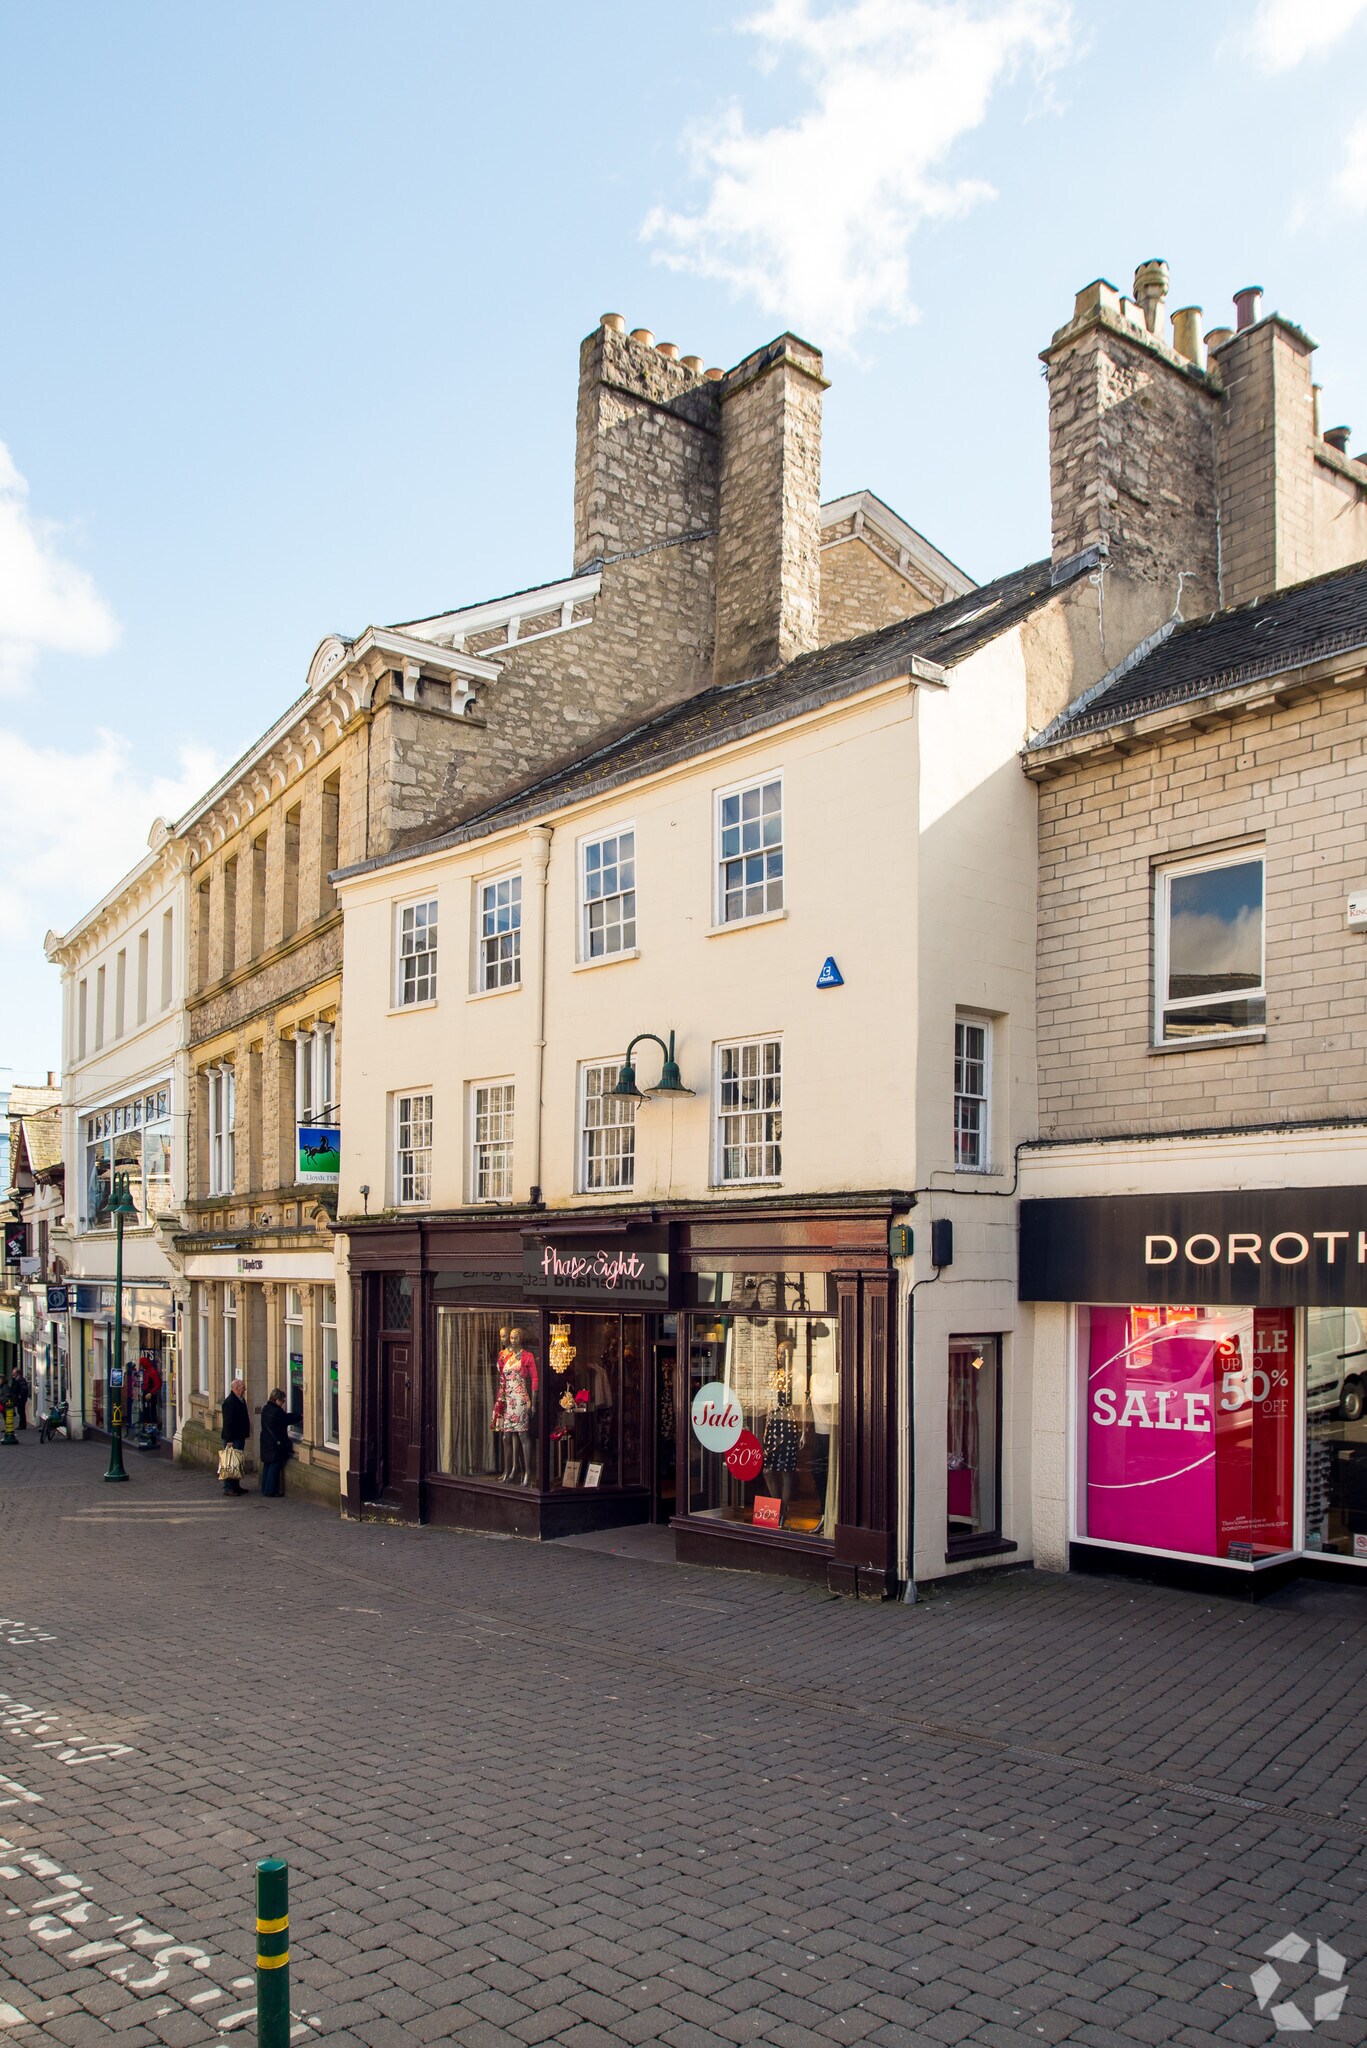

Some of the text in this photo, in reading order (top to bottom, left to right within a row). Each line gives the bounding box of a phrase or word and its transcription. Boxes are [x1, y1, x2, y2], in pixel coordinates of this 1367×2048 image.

[306, 1174, 325, 1182] Lloyds
[1145, 1231, 1367, 1265] DOROT
[541, 1246, 645, 1289] Phase Eight
[1220, 1330, 1288, 1355] SALE
[1221, 1358, 1240, 1371] UP
[1220, 1369, 1289, 1411] 50%
[693, 1402, 741, 1428] Sale
[1093, 1388, 1211, 1433] SALE
[1262, 1400, 1288, 1412] OFF
[727, 1449, 762, 1466] 50%
